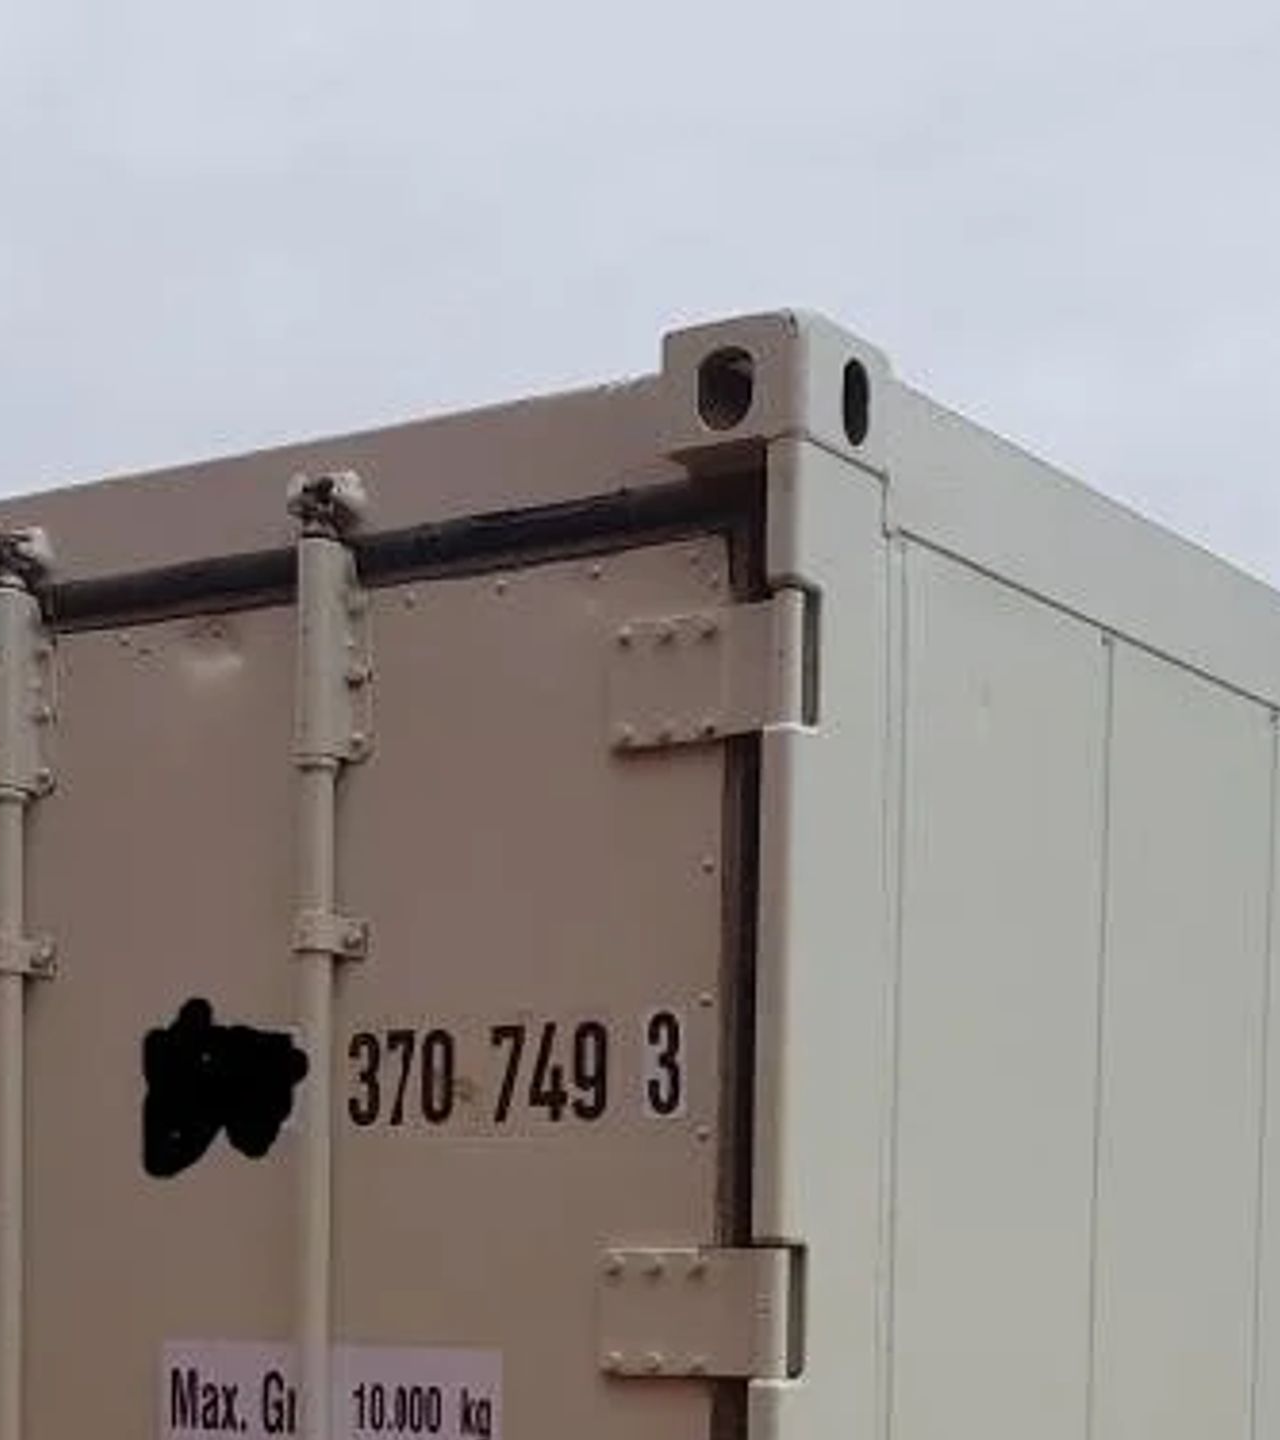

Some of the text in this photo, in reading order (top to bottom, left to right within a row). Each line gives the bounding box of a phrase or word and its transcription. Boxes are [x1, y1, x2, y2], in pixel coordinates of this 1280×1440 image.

[347, 1009, 680, 1127] 370 749 3
[170, 1367, 248, 1432] Max.
[352, 1381, 442, 1433] 10.000
